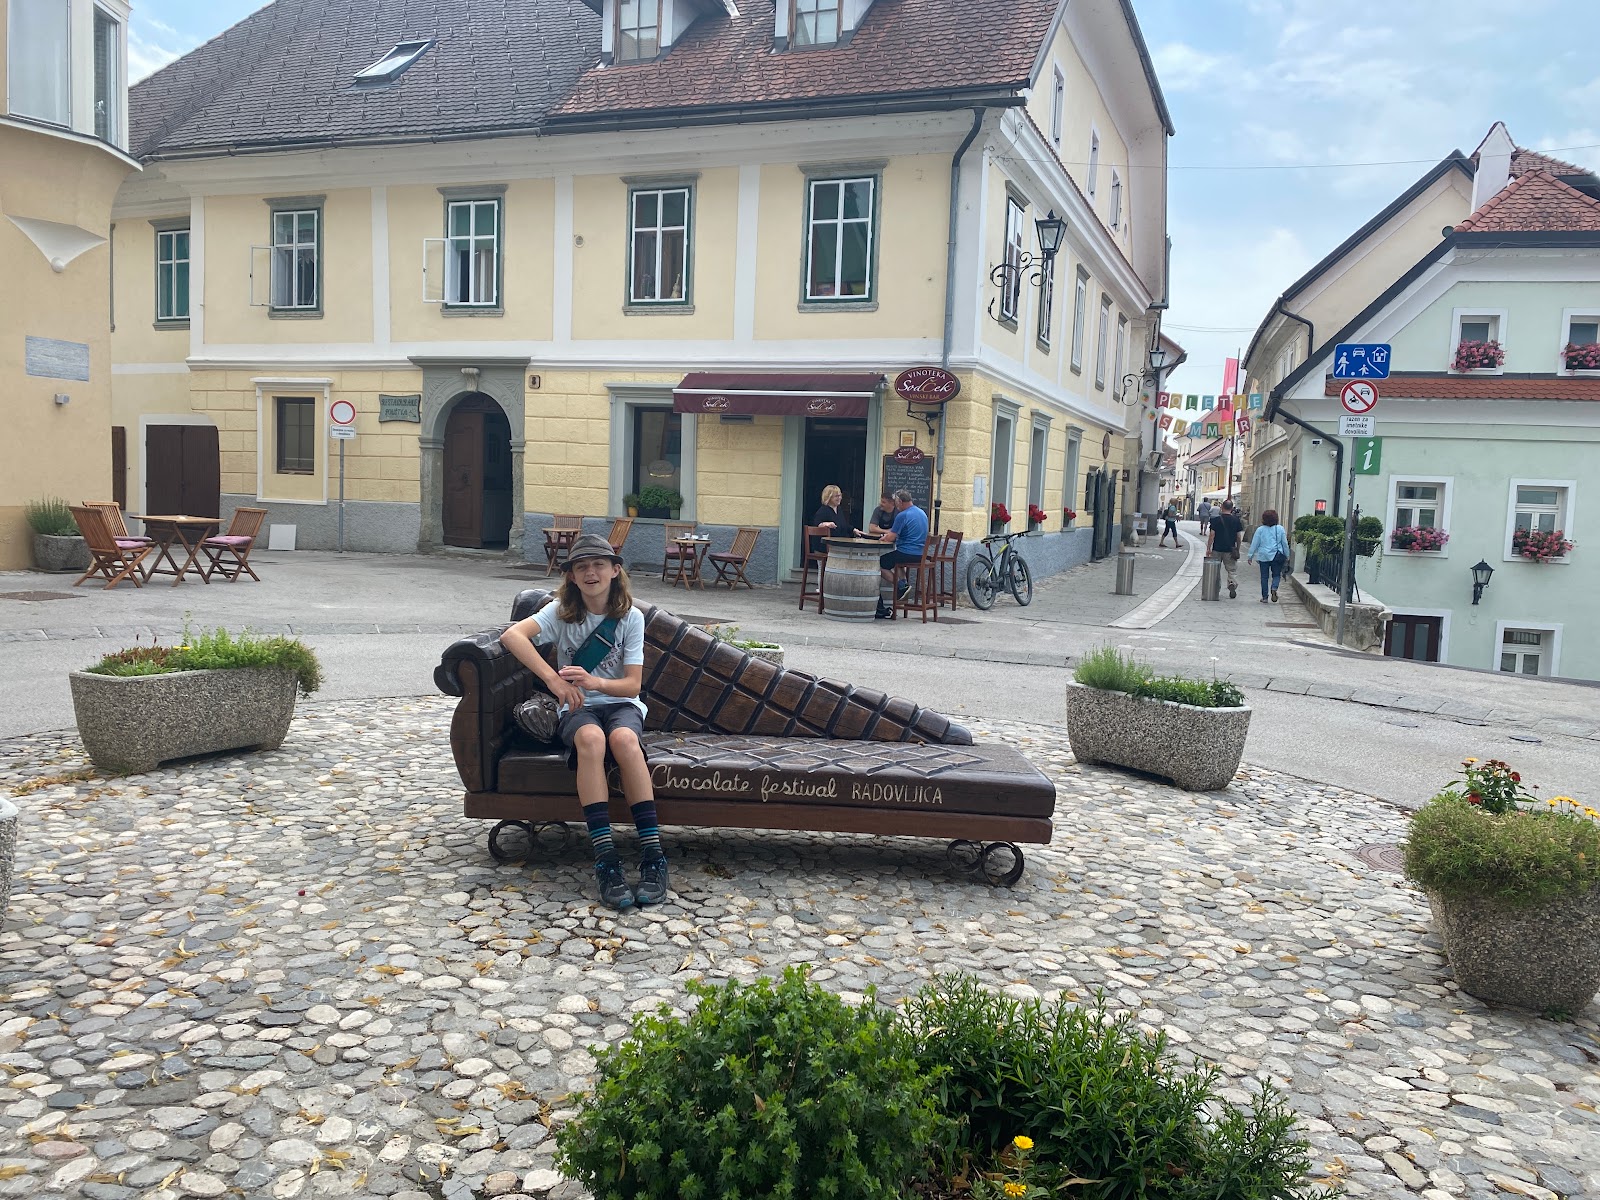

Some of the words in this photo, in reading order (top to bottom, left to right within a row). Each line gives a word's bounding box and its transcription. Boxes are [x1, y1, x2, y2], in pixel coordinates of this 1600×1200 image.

[908, 370, 946, 380] VINOTEKA
[1159, 395, 1261, 410] POLETJE
[1160, 417, 1250, 437] SUMMER
[650, 763, 753, 792] Chocolate
[761, 774, 838, 803] festival
[852, 782, 943, 804] RADOVLJICA
